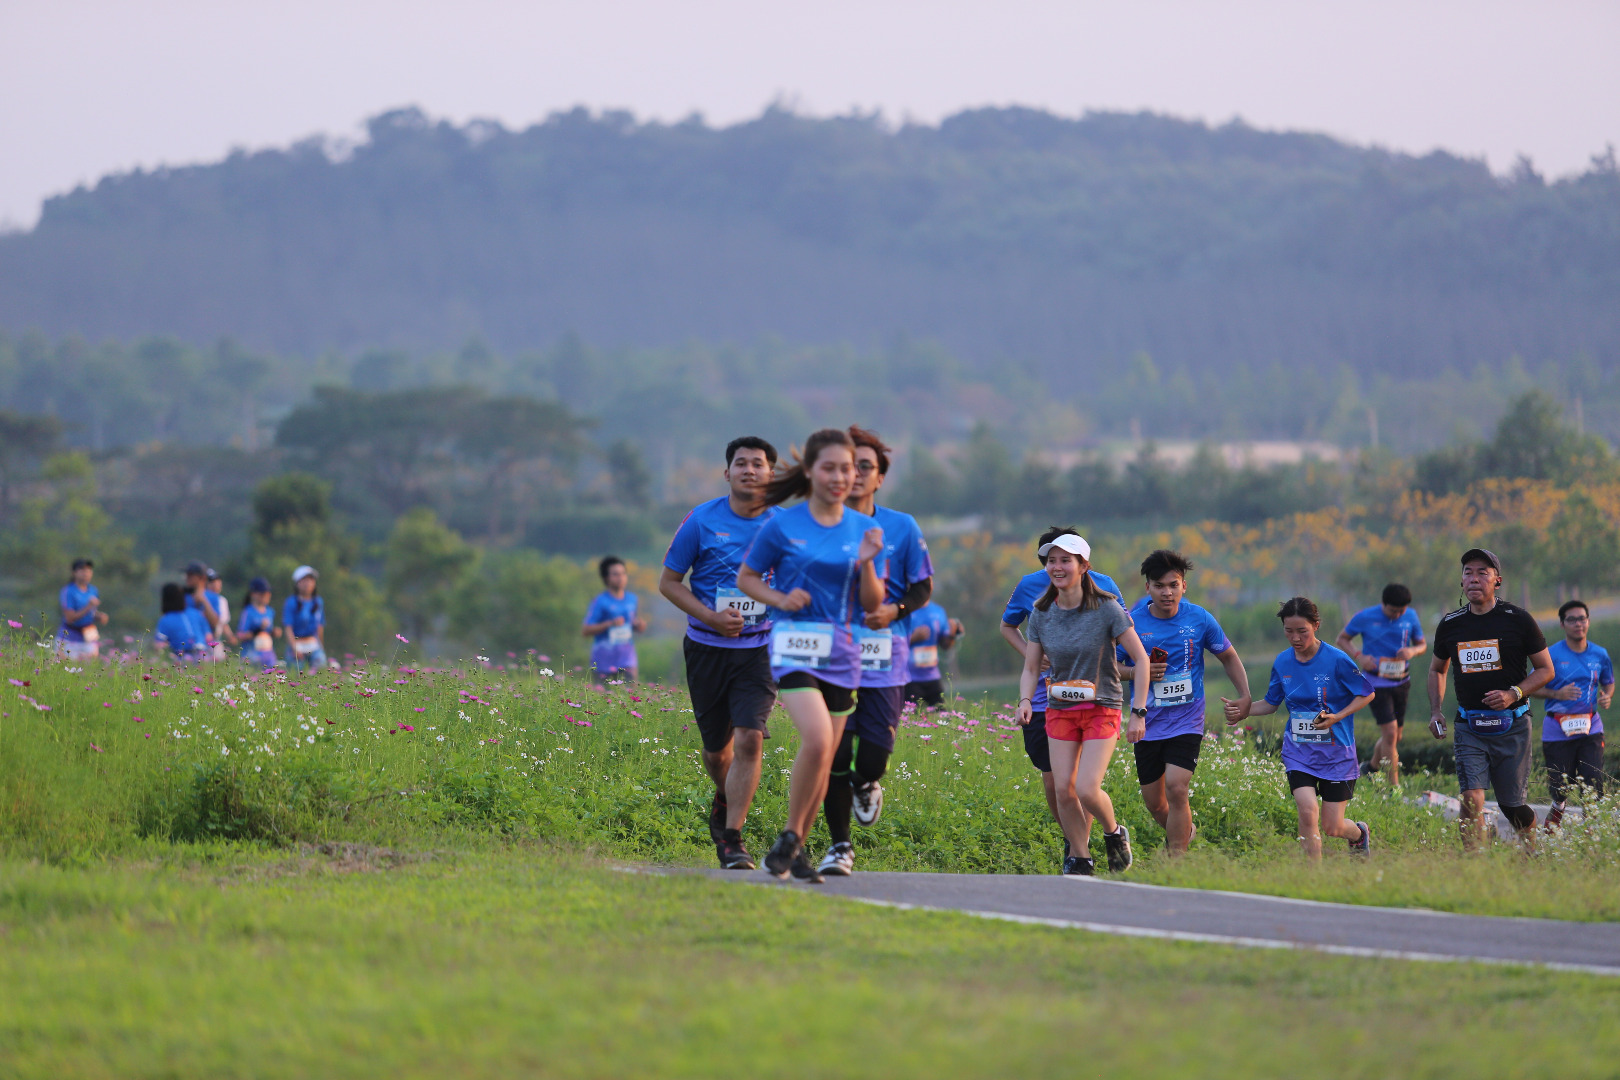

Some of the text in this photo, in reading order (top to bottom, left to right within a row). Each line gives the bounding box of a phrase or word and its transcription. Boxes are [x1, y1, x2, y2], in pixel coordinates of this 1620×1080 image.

[728, 601, 755, 611] 5101
[786, 638, 819, 650] 5055
[1466, 649, 1492, 662] 8066
[1163, 683, 1185, 694] 5155
[1061, 690, 1085, 700] 8494
[1298, 722, 1317, 731] 515
